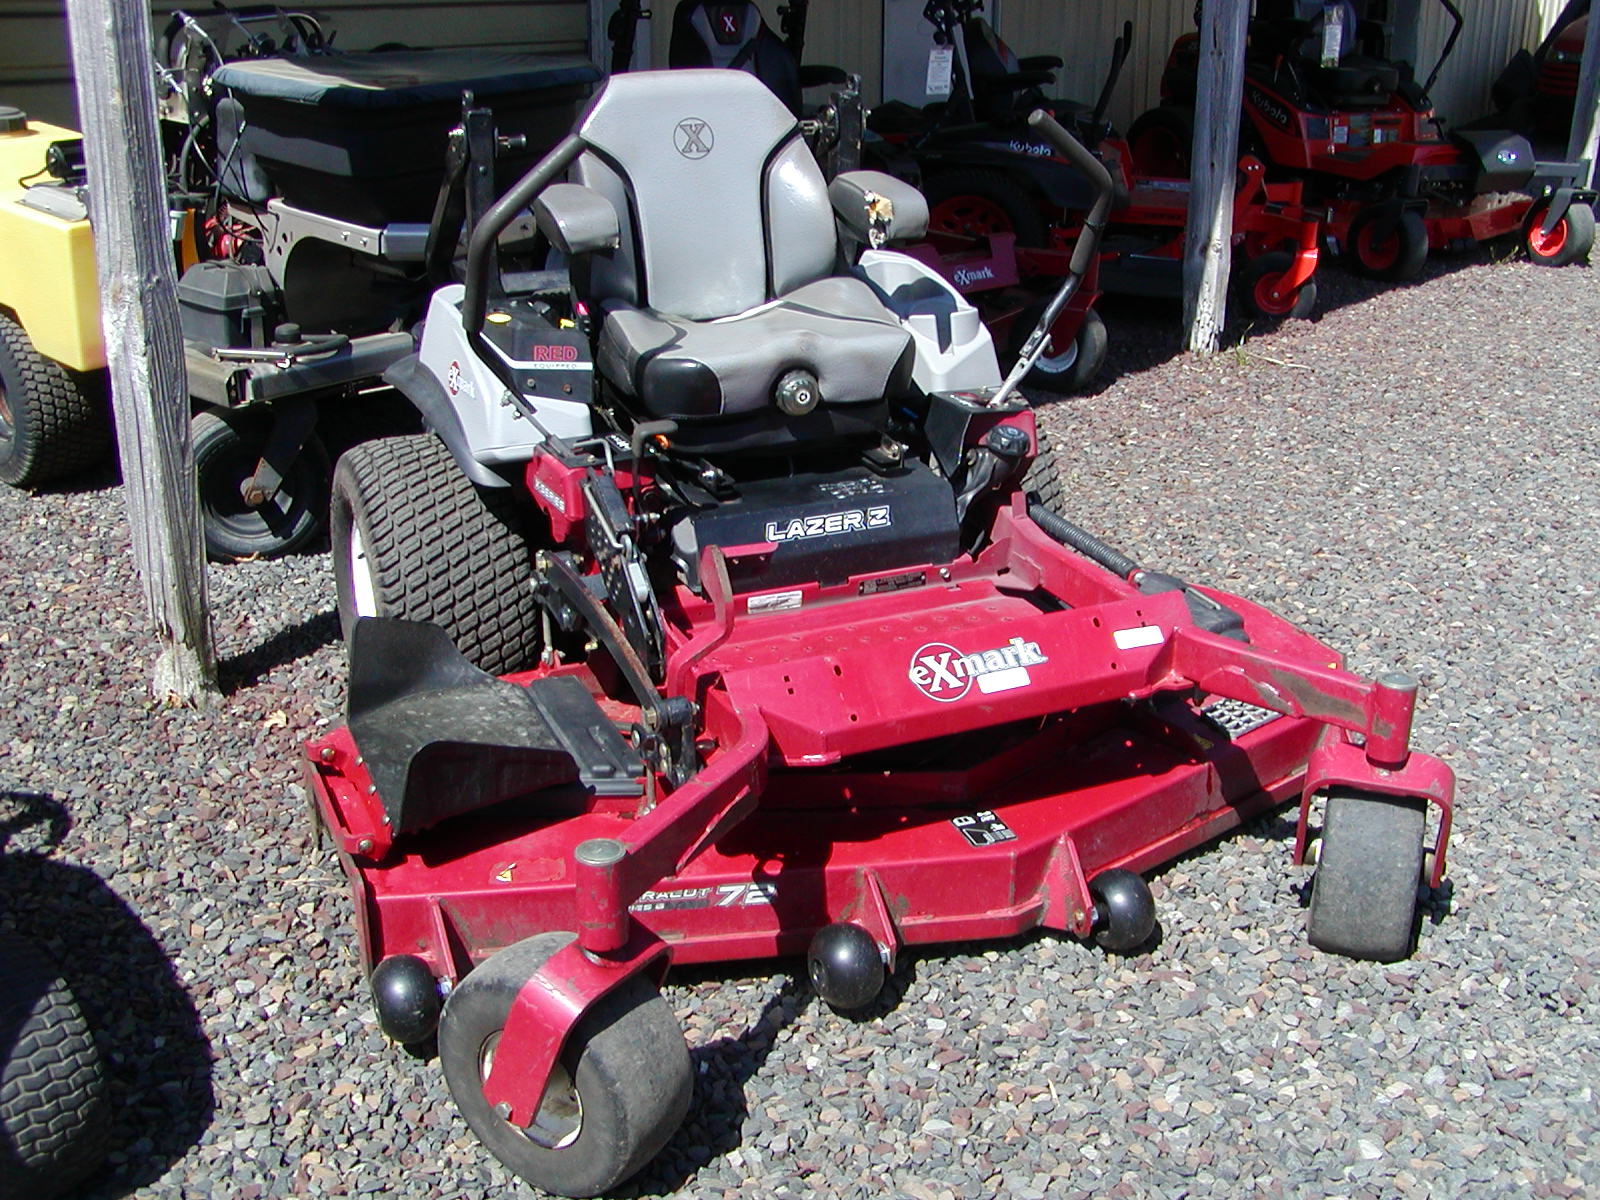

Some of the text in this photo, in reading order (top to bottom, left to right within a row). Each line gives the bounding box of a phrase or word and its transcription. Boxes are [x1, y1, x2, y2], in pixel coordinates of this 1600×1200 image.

[1251, 90, 1288, 124] Kubota
[1010, 139, 1051, 156] Kubota
[533, 344, 578, 361] RED
[765, 504, 892, 543] LAZER Z
[716, 883, 779, 906] 72
